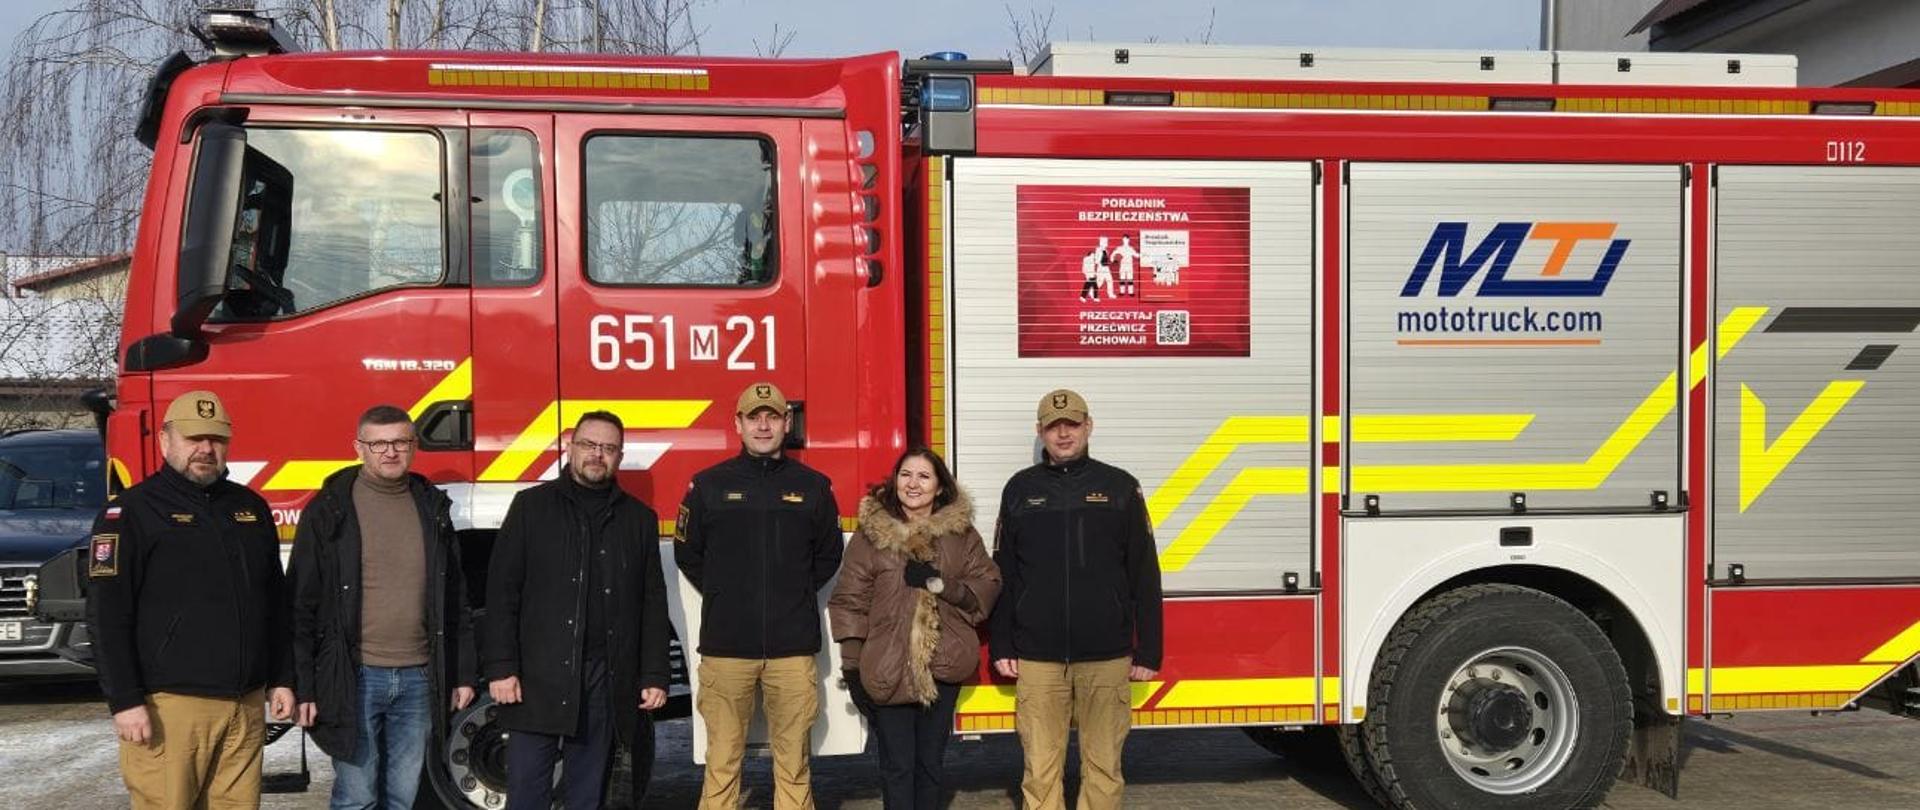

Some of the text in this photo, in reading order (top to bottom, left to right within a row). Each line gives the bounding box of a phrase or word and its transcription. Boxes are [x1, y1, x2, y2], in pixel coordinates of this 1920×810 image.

[1102, 198, 1166, 208] PORADNIK
[1080, 311, 1153, 320] PRZECZYTAJ
[1398, 306, 1602, 332] mototruck.com
[590, 314, 776, 371] 651 M 21
[1080, 335, 1147, 345] ZACHOWAJ!
[400, 360, 456, 371] 18.320
